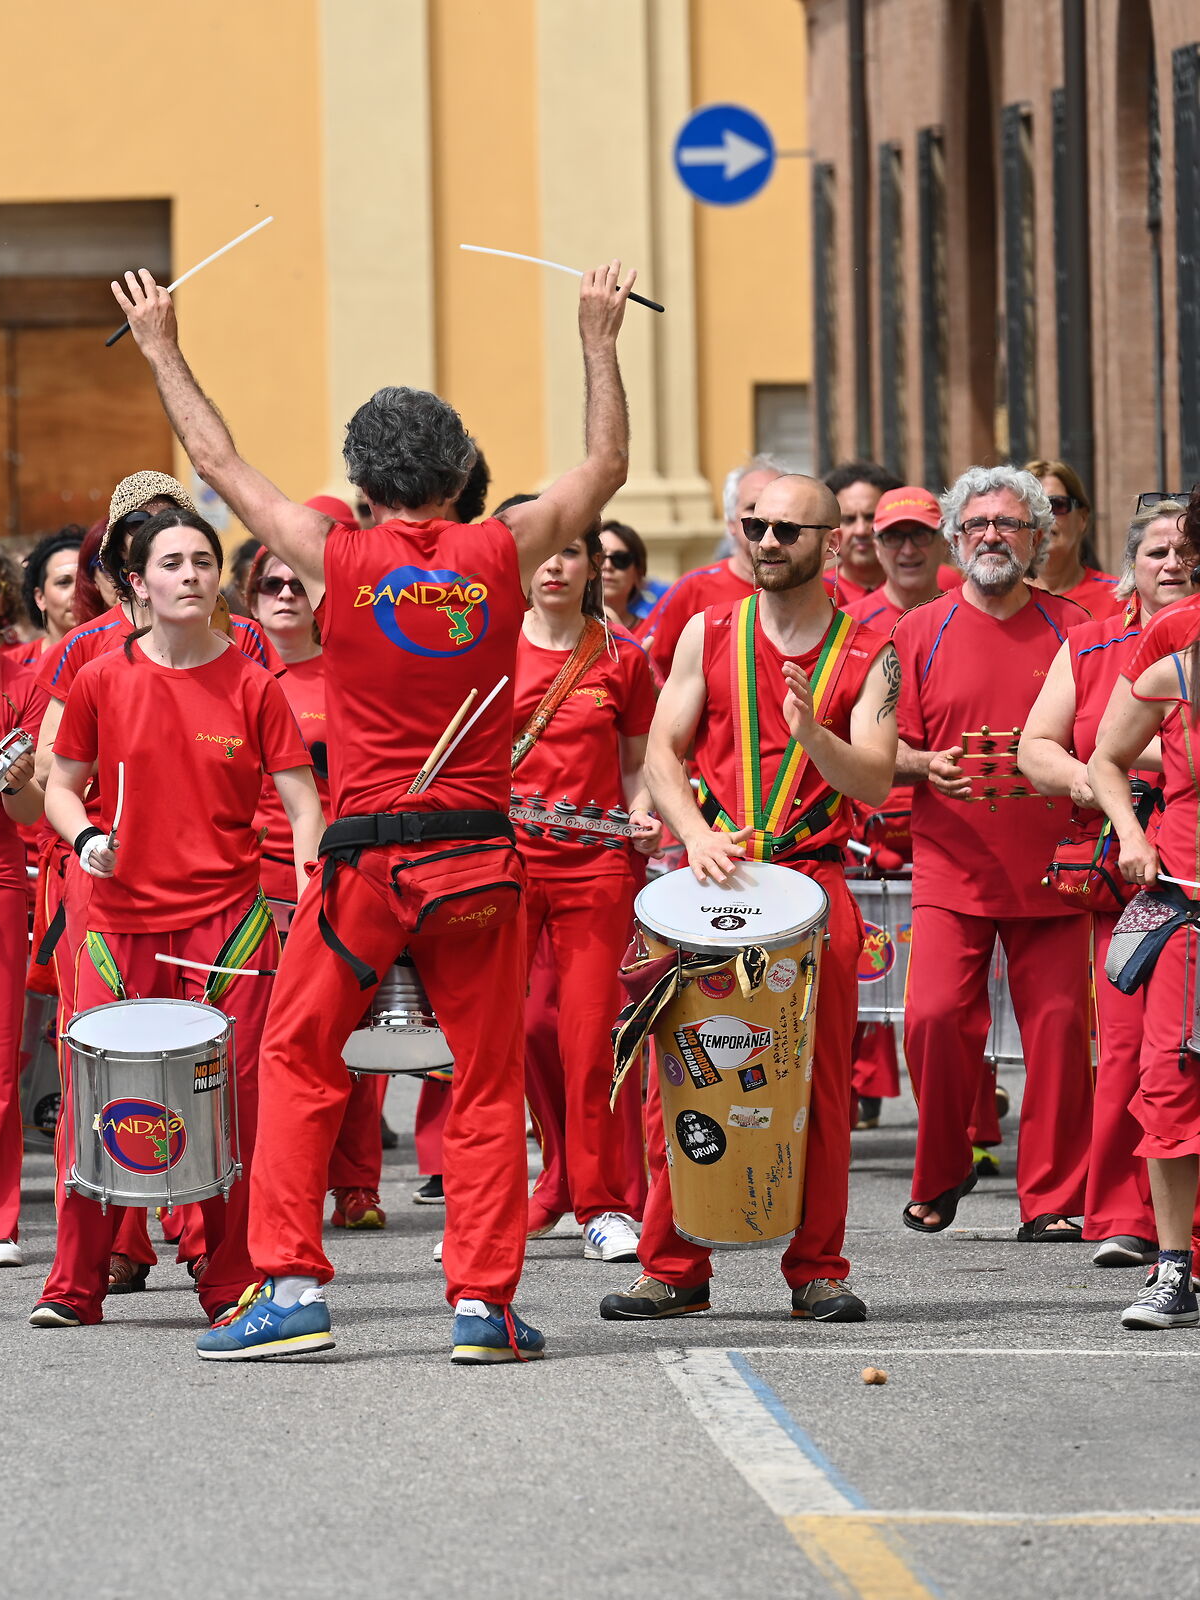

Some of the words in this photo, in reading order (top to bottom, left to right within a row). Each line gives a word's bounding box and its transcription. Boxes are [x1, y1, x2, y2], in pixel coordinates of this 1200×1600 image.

[700, 905, 763, 915] TIMBRA
[698, 1032, 771, 1049] TEMPORÂNEA
[682, 1048, 702, 1077] BOARD
[684, 1029, 698, 1046] NO
[691, 1045, 719, 1084] BORDERS
[691, 1142, 720, 1159] DRUM
